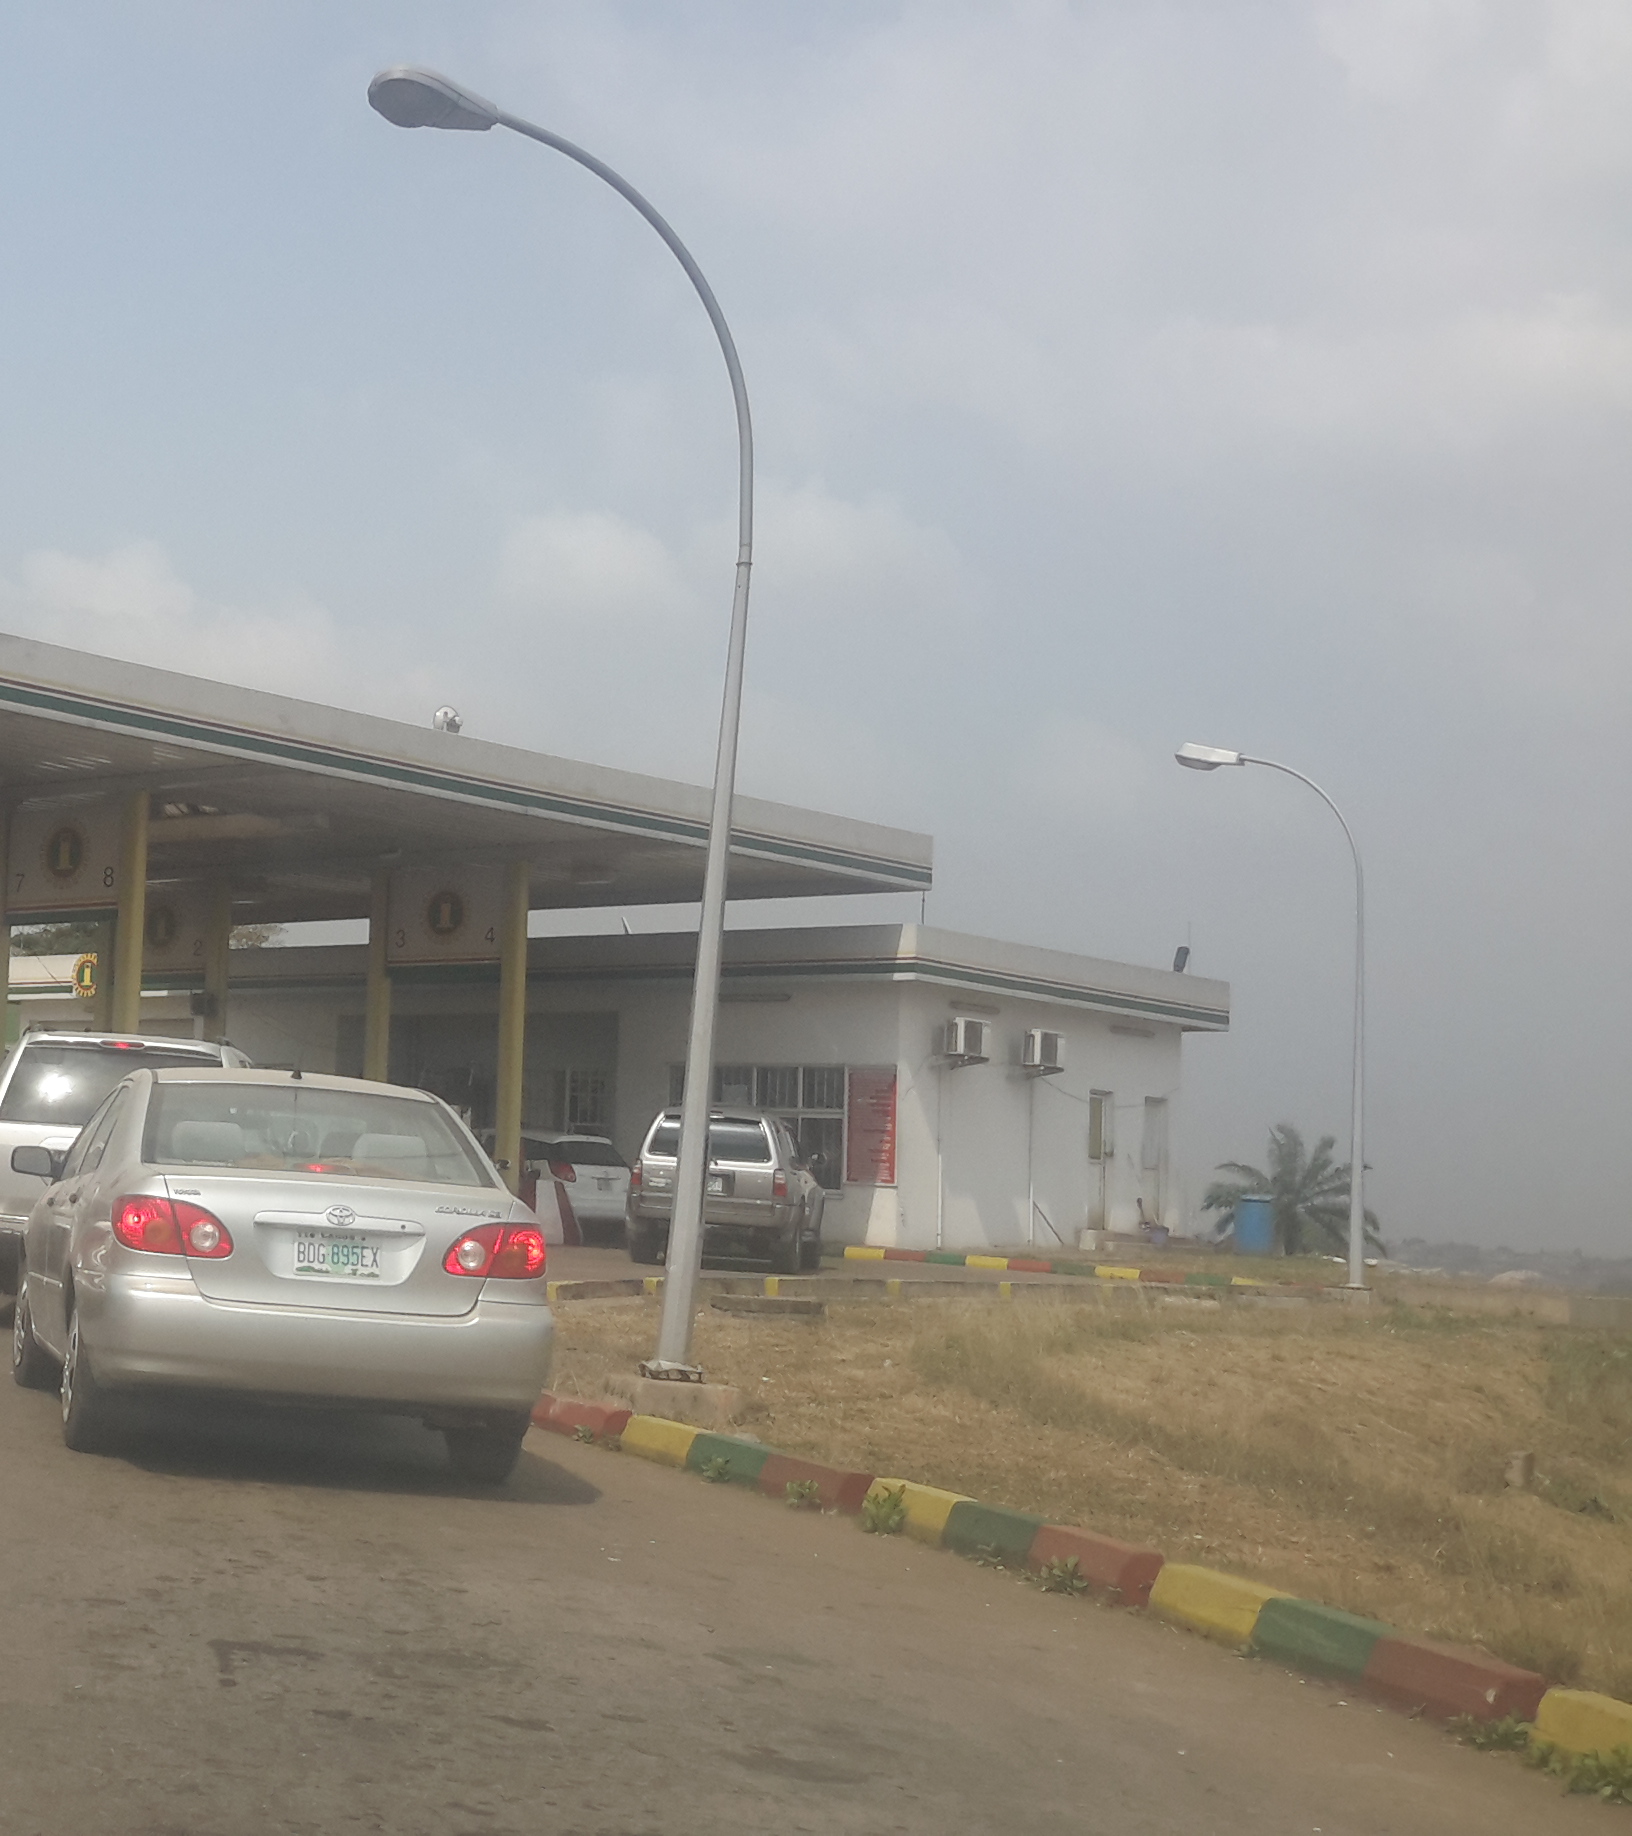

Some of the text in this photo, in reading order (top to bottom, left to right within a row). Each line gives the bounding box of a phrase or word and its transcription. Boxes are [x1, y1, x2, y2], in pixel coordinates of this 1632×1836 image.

[15, 873, 25, 893] 7
[103, 866, 114, 888] 8
[394, 929, 406, 949] 3
[484, 926, 496, 943] 4
[193, 939, 203, 957] 2
